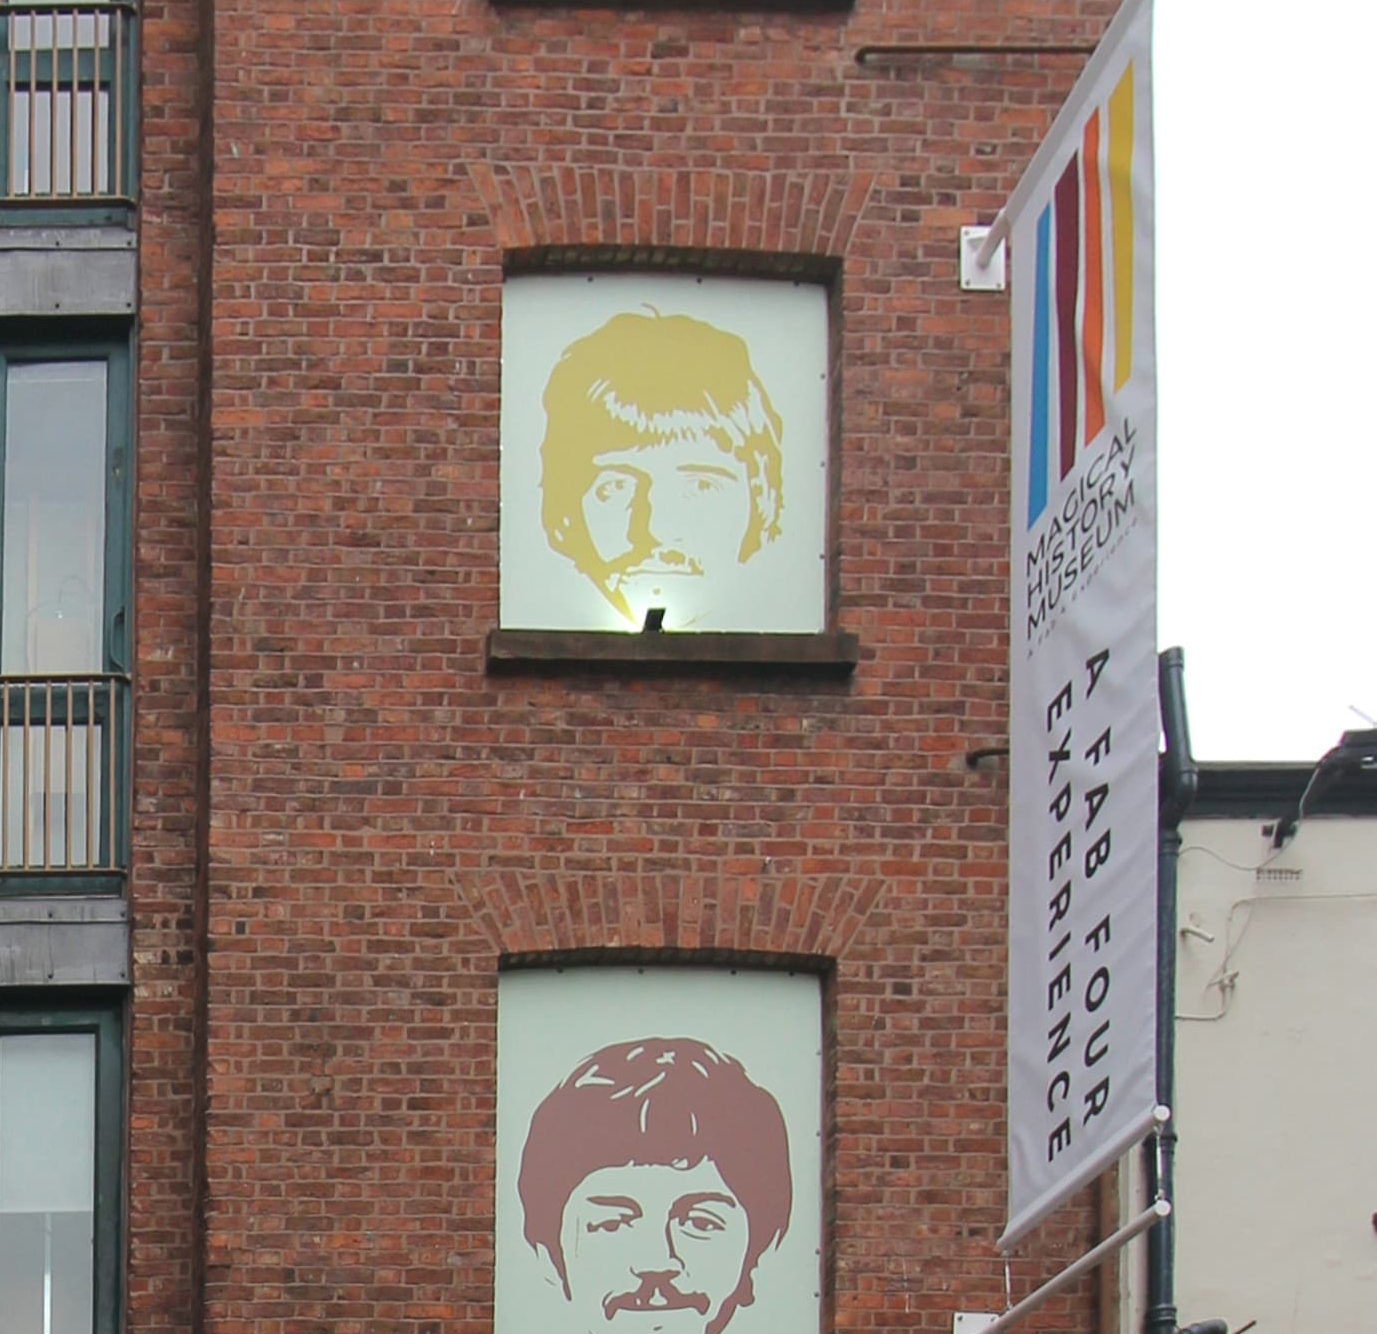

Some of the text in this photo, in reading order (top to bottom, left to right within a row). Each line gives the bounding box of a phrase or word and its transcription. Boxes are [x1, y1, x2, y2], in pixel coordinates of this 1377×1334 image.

[1026, 417, 1137, 579] MAGICAL
[1027, 443, 1136, 609] HISTORY
[1027, 477, 1135, 641] MUSEUM
[1047, 679, 1073, 1163] EXPERIENCE
[1083, 648, 1112, 1126] A FAB FOUR
